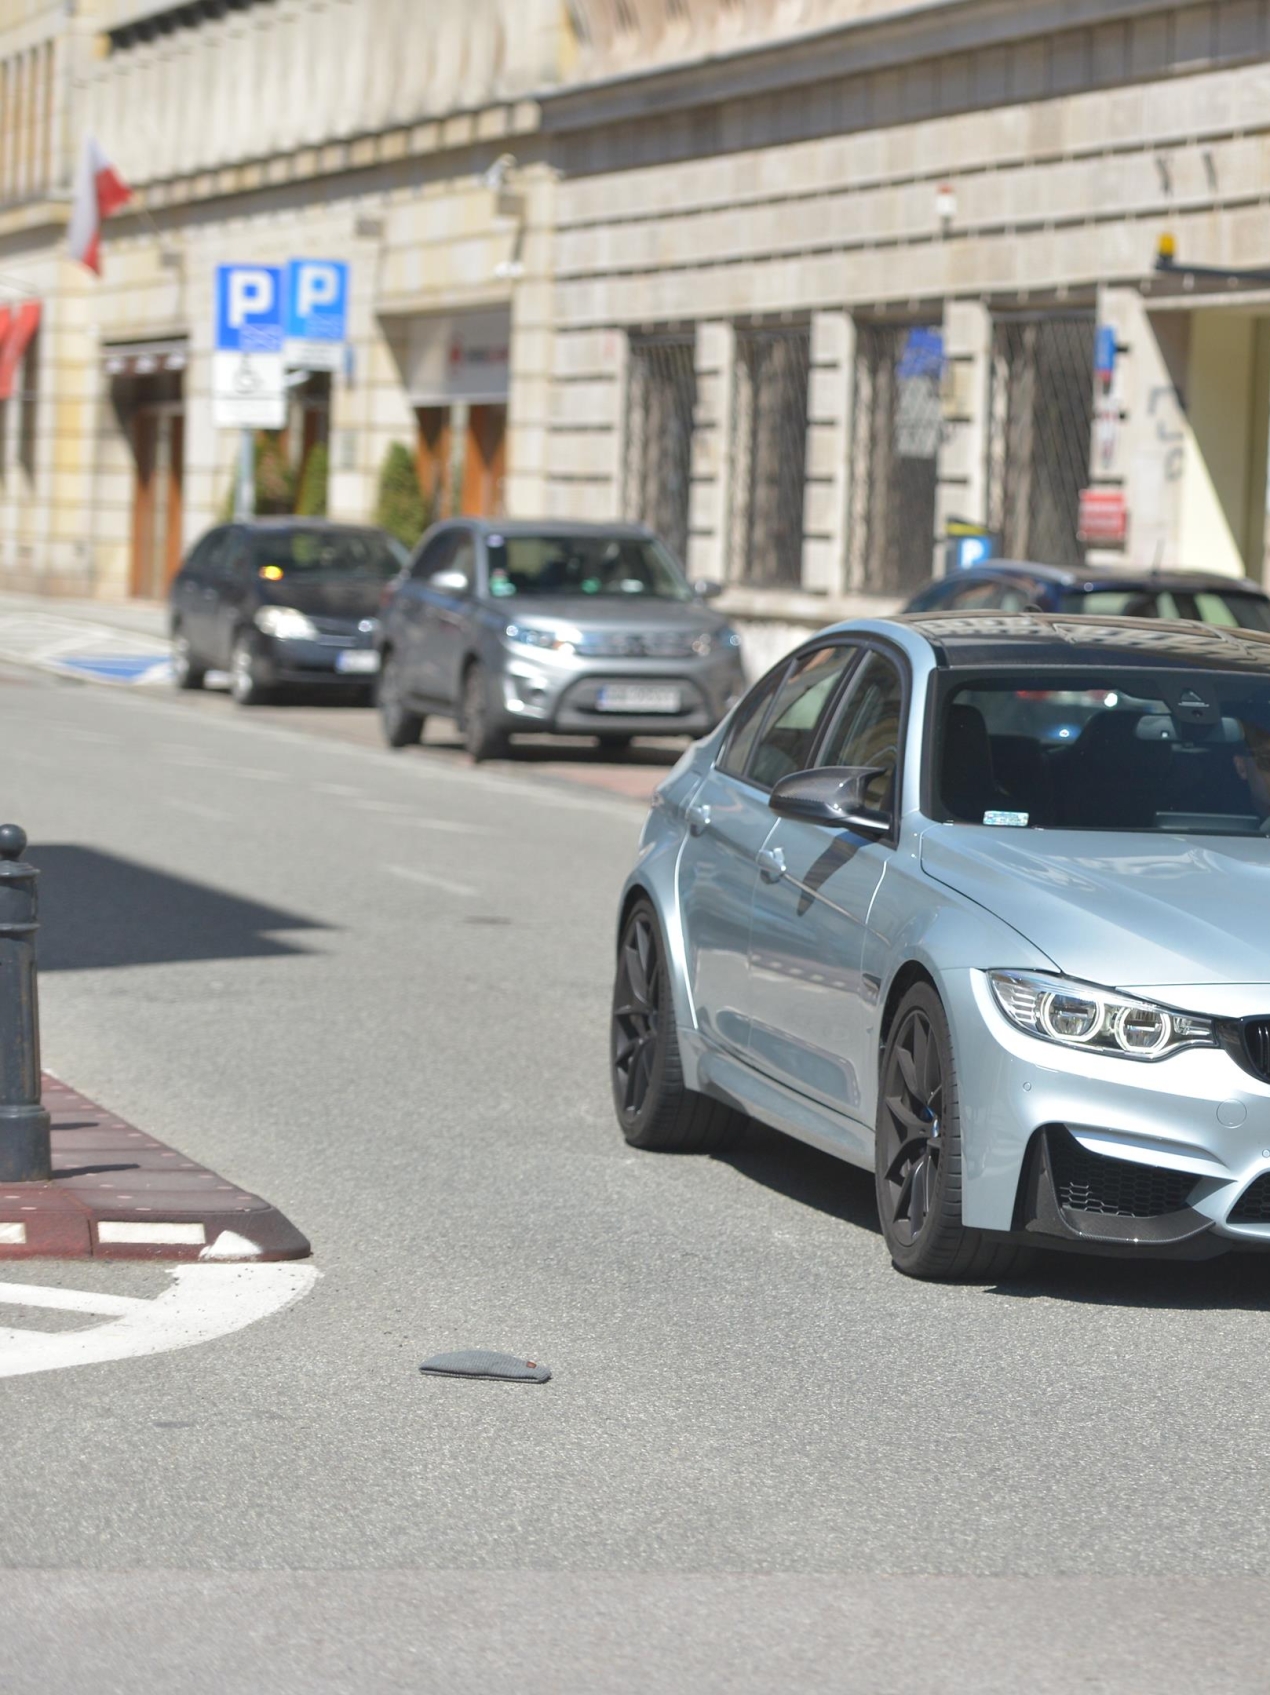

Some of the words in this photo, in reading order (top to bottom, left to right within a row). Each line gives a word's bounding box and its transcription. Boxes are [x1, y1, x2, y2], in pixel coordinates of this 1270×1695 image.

[228, 268, 275, 330] P
[297, 263, 338, 318] P
[960, 538, 985, 569] P
